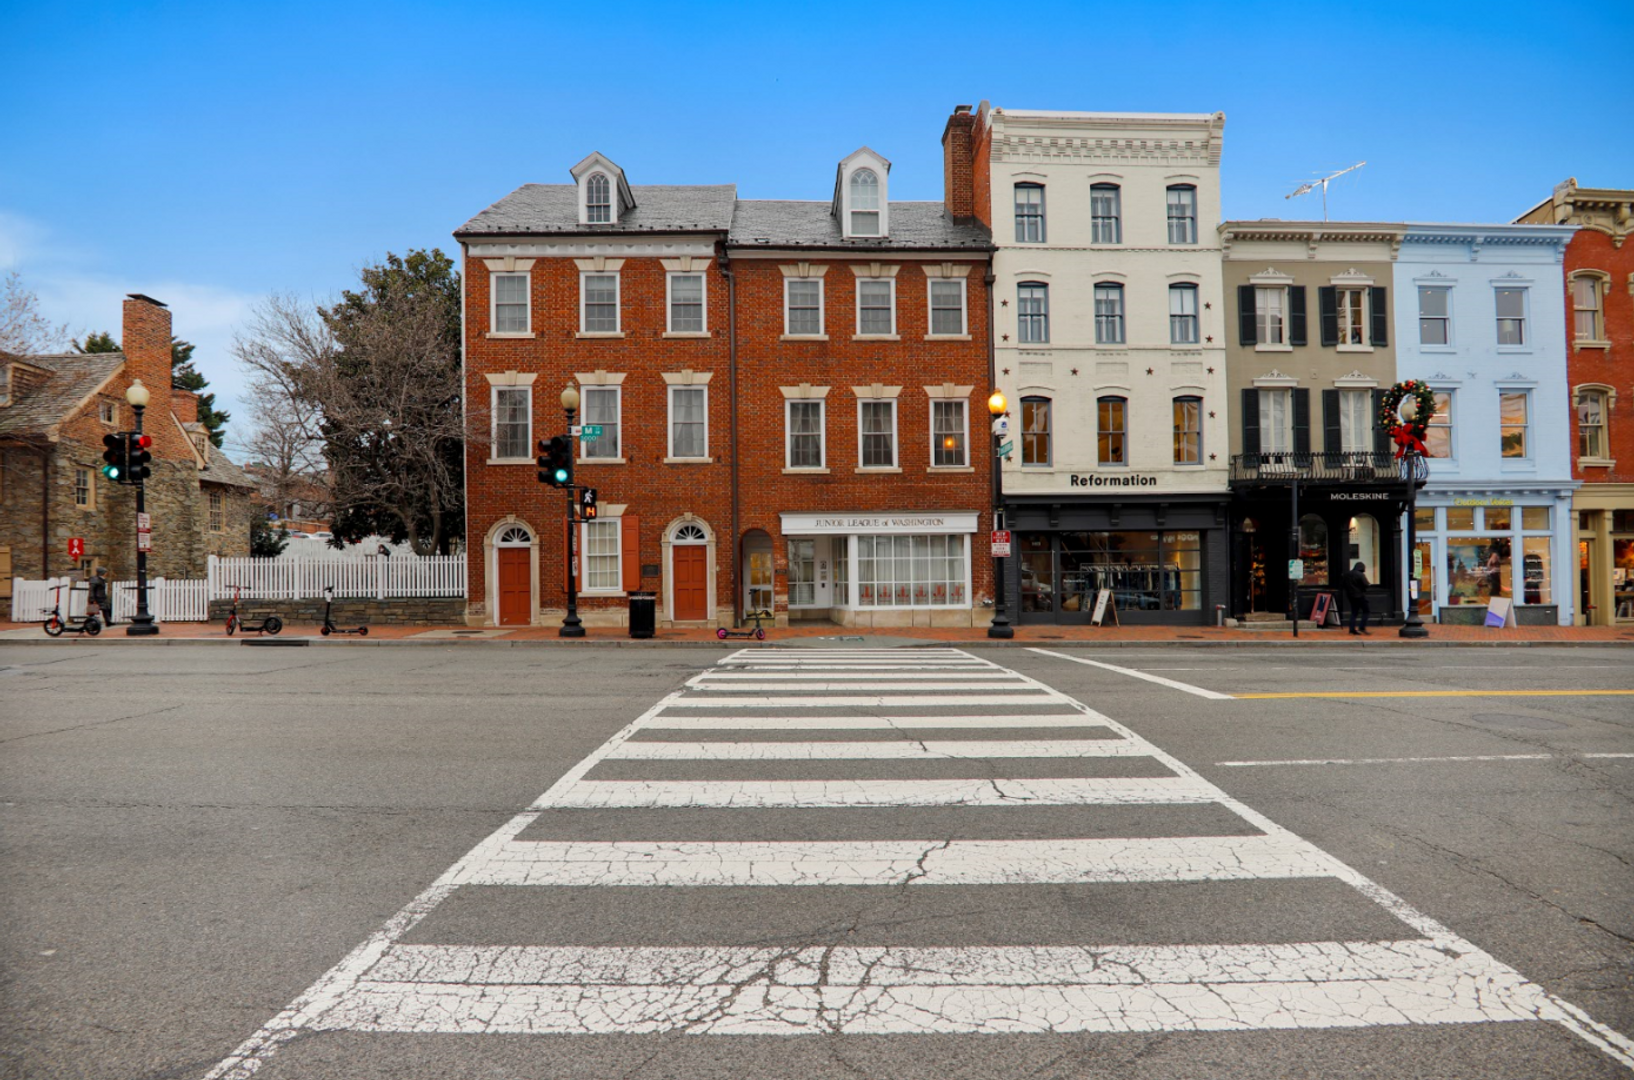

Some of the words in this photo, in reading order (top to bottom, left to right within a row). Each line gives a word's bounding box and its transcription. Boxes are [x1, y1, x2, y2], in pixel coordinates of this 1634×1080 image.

[584, 427, 593, 435] M
[1070, 474, 1157, 487] Reformation
[1330, 492, 1390, 501] MOLESKINE
[585, 506, 595, 517] 14
[815, 519, 845, 528] JUNIOR
[847, 519, 879, 528] LEAGUE
[891, 518, 944, 527] WASHINGTON
